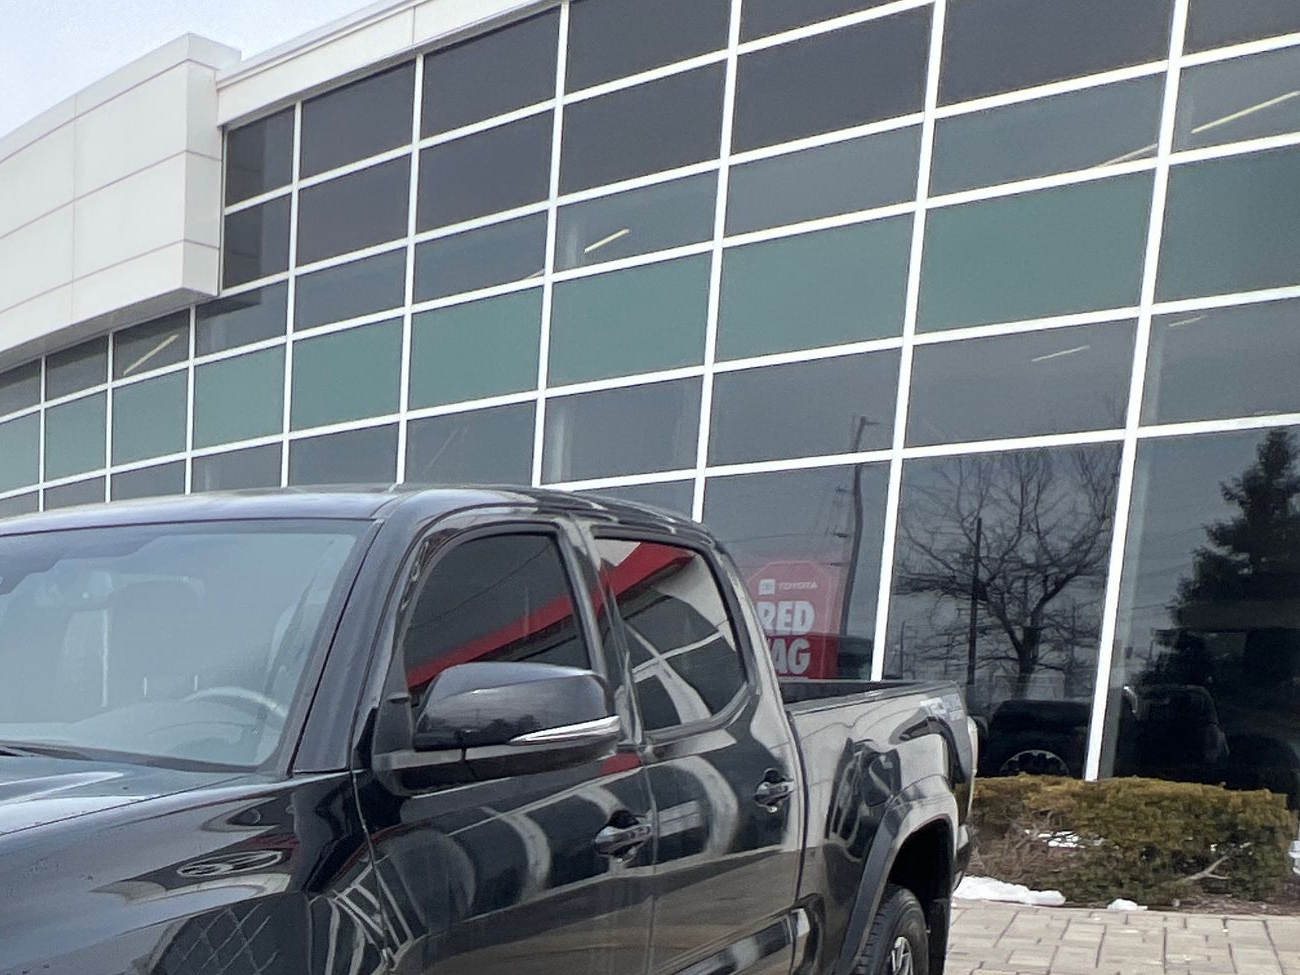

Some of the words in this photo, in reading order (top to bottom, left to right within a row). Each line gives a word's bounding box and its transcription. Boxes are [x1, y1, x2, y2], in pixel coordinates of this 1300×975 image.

[779, 582, 818, 592] TOYOTA
[757, 601, 815, 636] RED
[767, 637, 811, 675] AG
